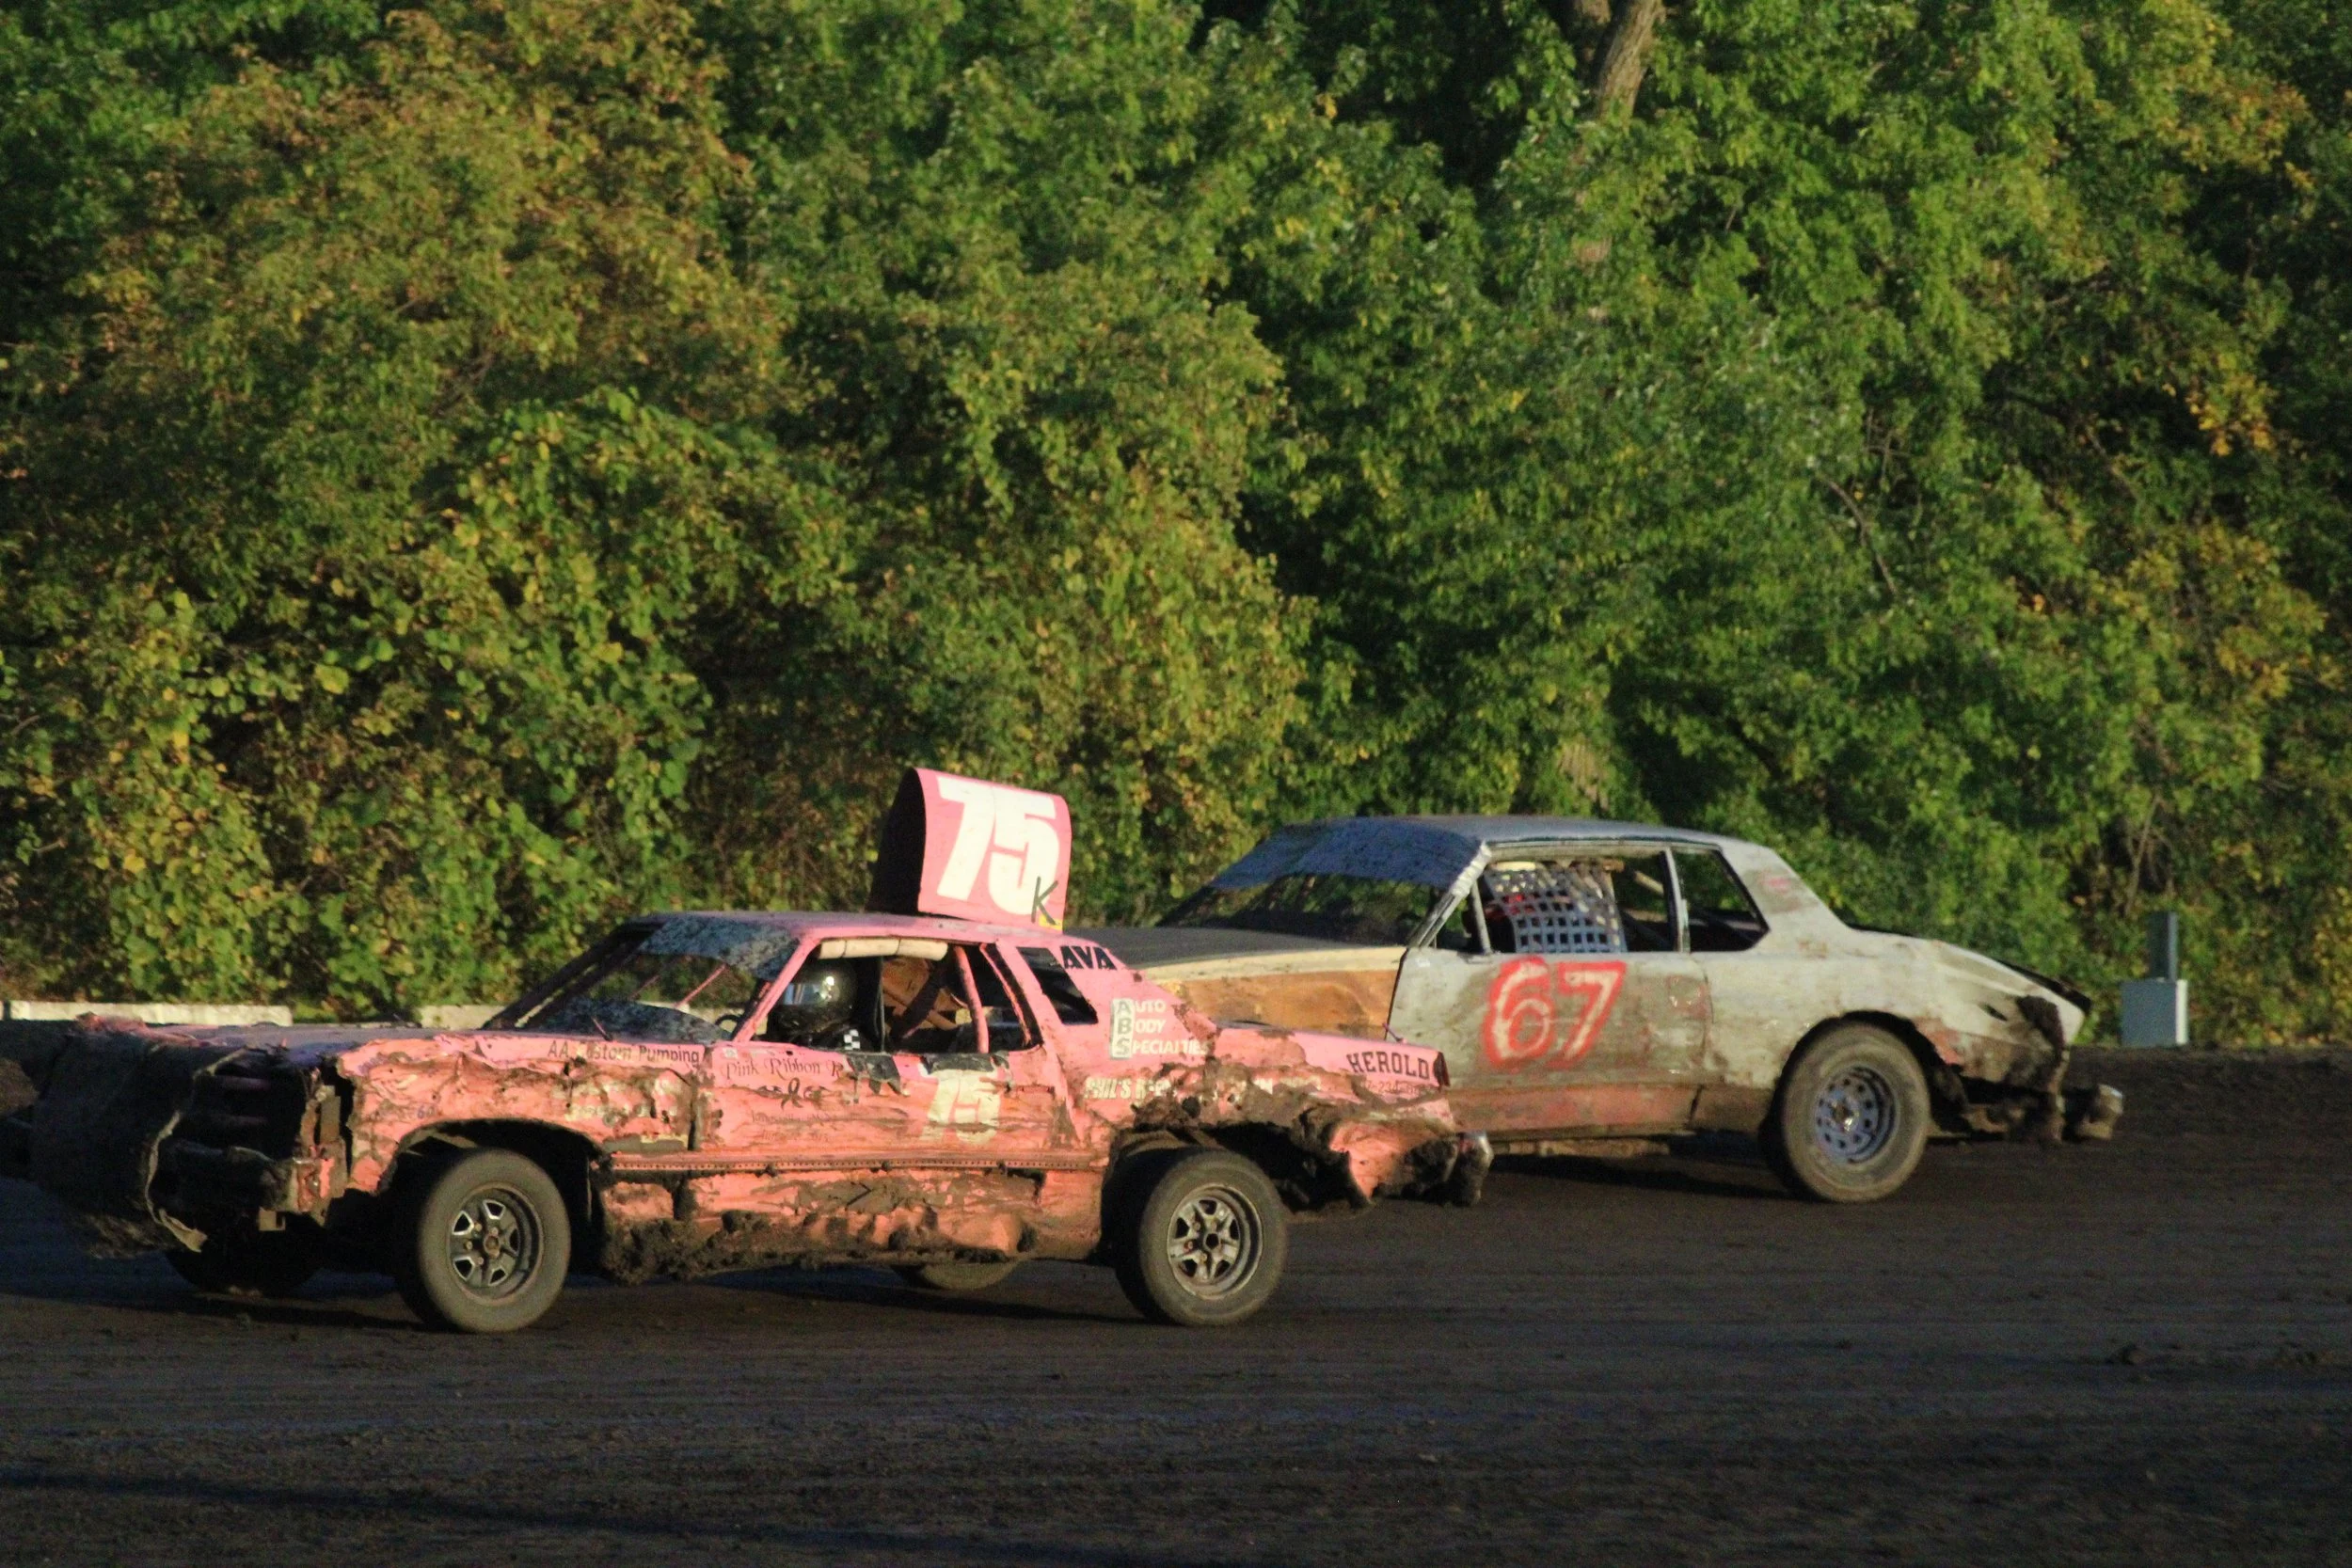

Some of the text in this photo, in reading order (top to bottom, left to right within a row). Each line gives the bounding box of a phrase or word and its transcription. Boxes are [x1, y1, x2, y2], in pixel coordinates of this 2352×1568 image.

[936, 776, 1059, 916] 75
[1031, 876, 1059, 926] K
[1059, 945, 1118, 971] AVA
[1117, 999, 1167, 1014] AUTO
[1481, 955, 1627, 1070] 67
[1117, 1018, 1167, 1035] BODY
[548, 1039, 569, 1058] AA
[639, 1044, 701, 1069] Pumping
[1345, 1051, 1430, 1080] HEROLD
[724, 1060, 759, 1080] Pink
[763, 1057, 820, 1081] Ribbon
[919, 1064, 1002, 1146] 75
